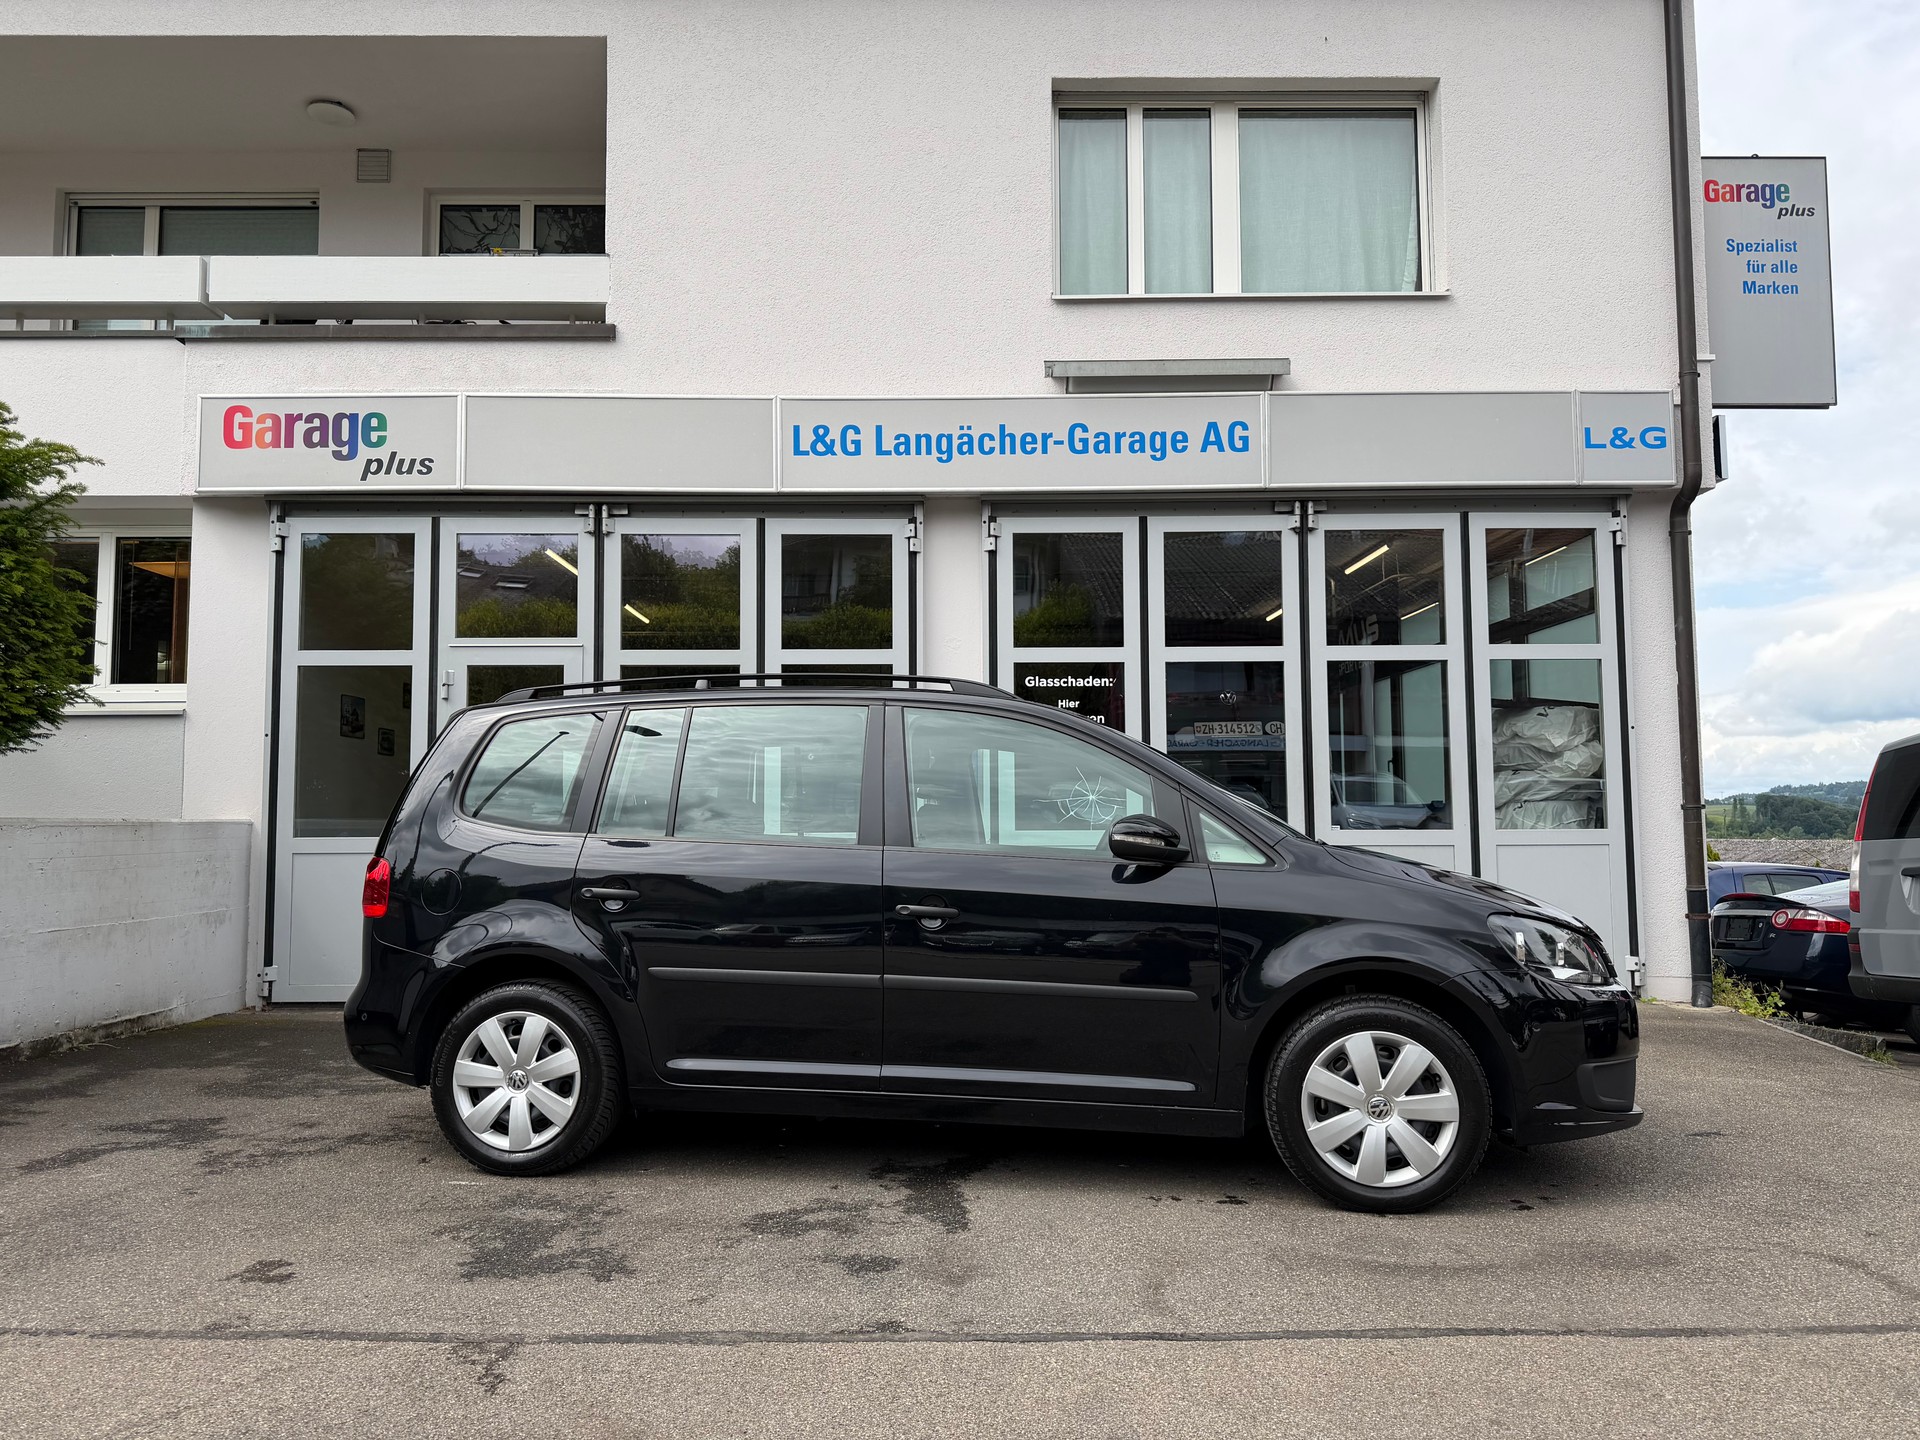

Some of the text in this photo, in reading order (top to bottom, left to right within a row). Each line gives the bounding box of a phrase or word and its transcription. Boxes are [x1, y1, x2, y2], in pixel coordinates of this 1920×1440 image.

[1703, 179, 1790, 209] Garage
[1777, 204, 1816, 220] plus
[1726, 238, 1798, 256] Spezialist
[1746, 260, 1798, 274] für alle
[1742, 280, 1799, 295] Marken
[222, 404, 388, 462] Garage
[1583, 426, 1667, 449] L&G
[792, 420, 1251, 464] L&G Langächer-Garage AG
[360, 451, 435, 482] plus
[1024, 675, 1114, 687] Glasschaden:
[1057, 699, 1080, 708] Hier
[1269, 723, 1283, 734] CH
